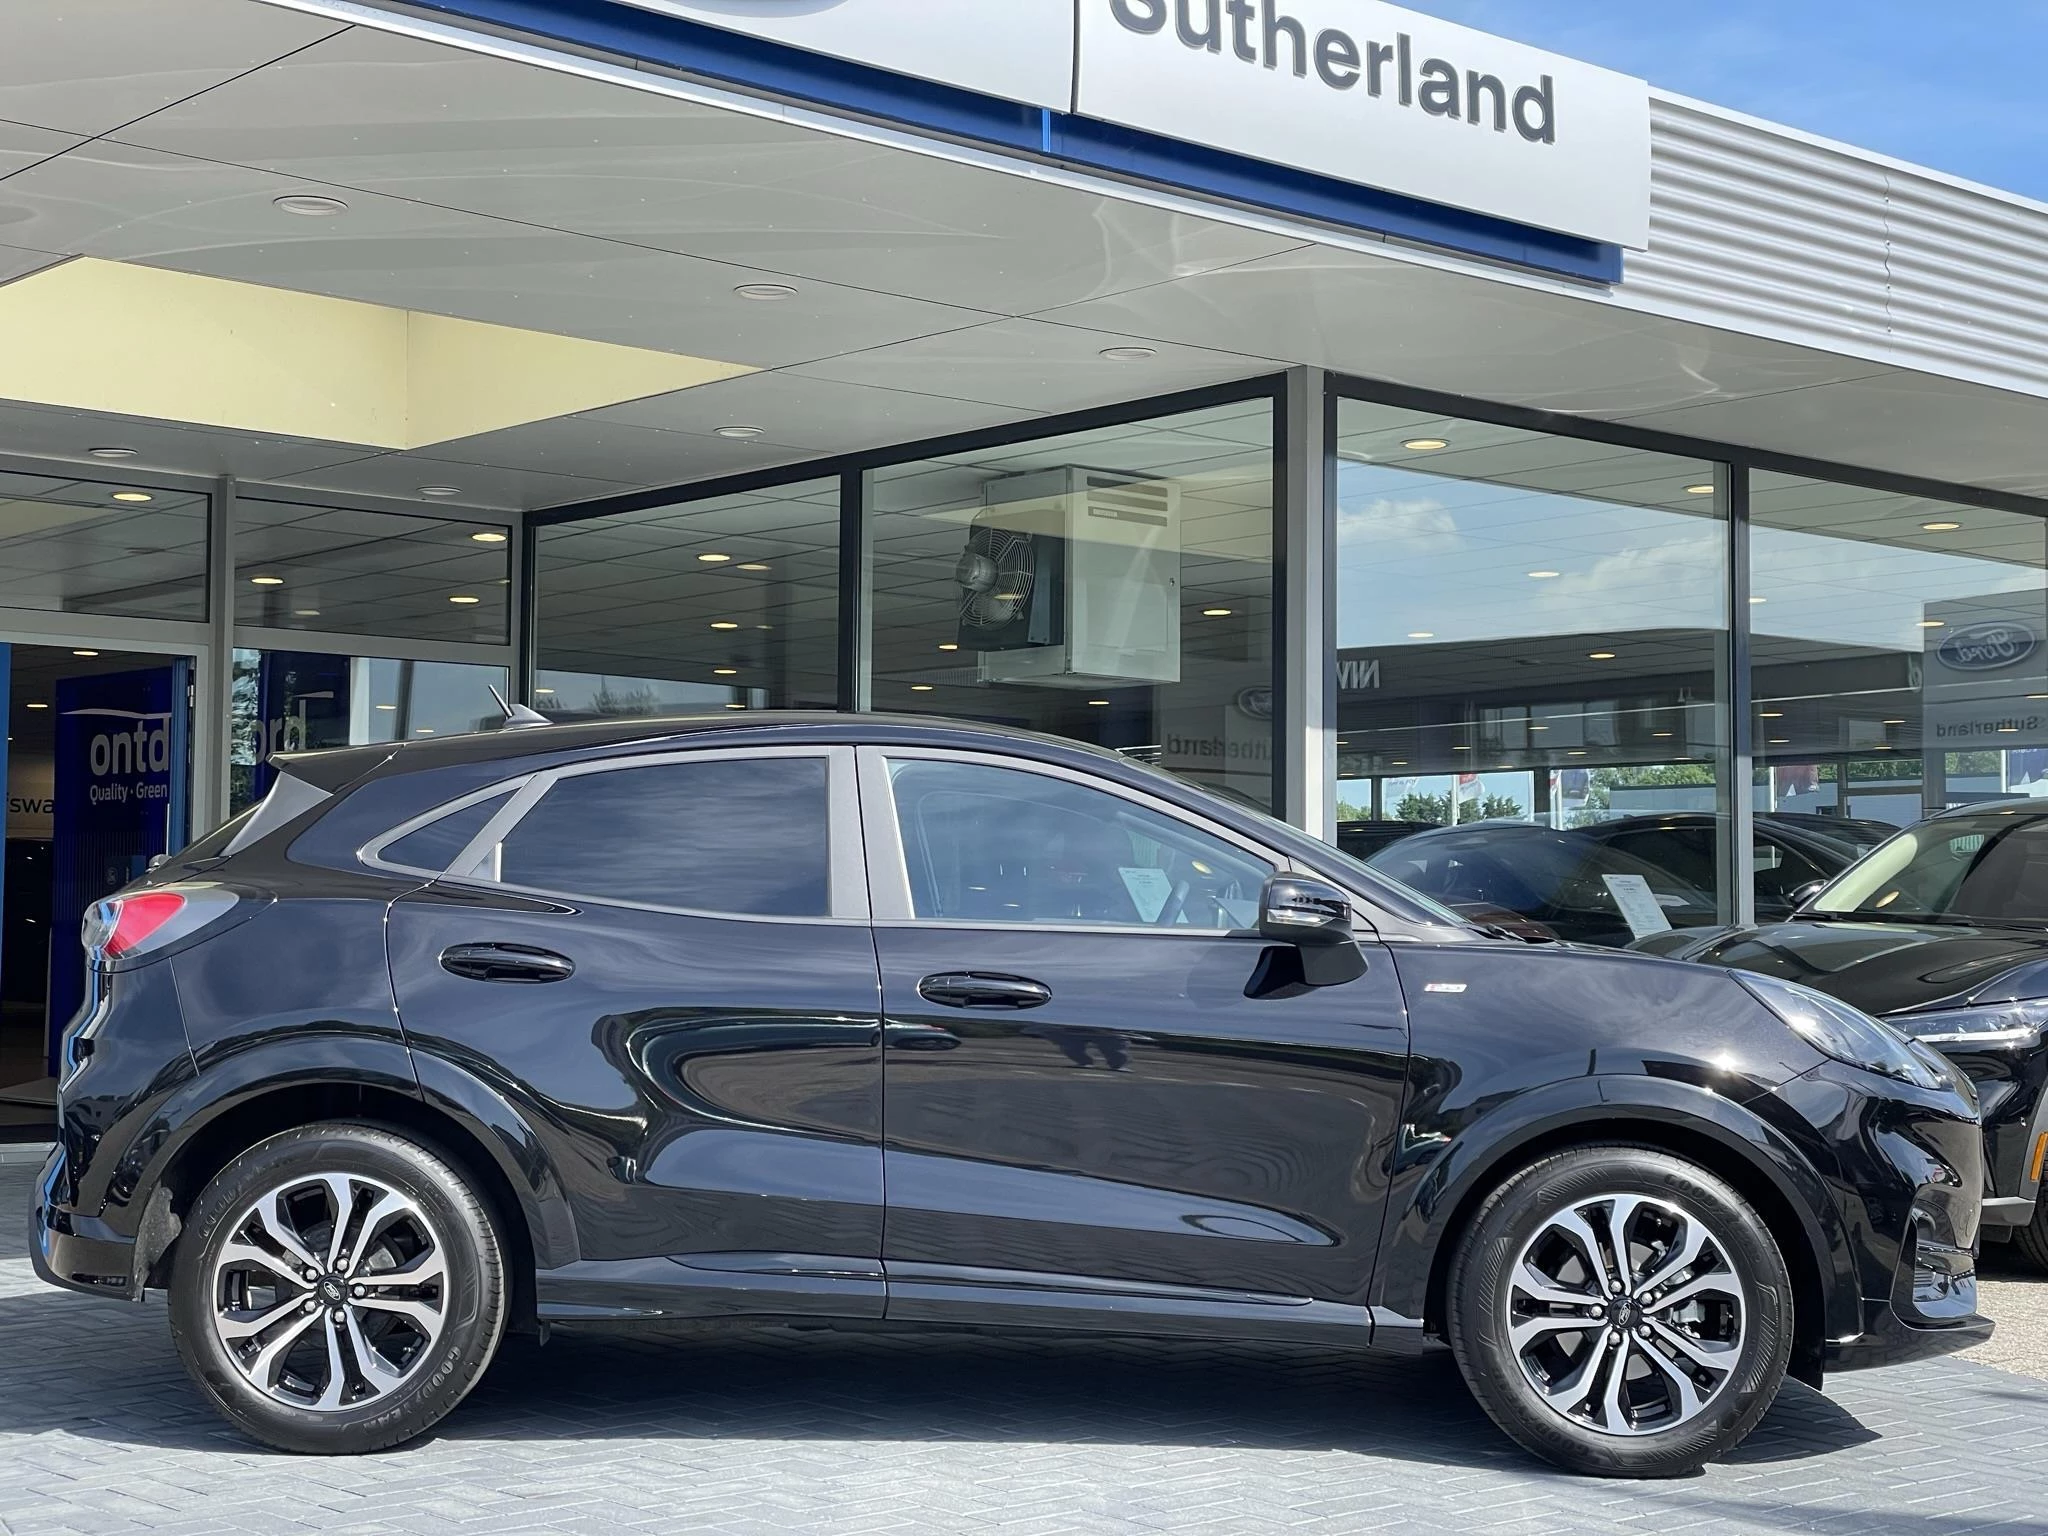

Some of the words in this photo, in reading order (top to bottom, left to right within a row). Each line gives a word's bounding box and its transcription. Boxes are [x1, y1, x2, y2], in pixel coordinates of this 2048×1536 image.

[90, 717, 170, 776] ontd
[90, 783, 128, 805] Quality
[136, 781, 168, 799] Green
